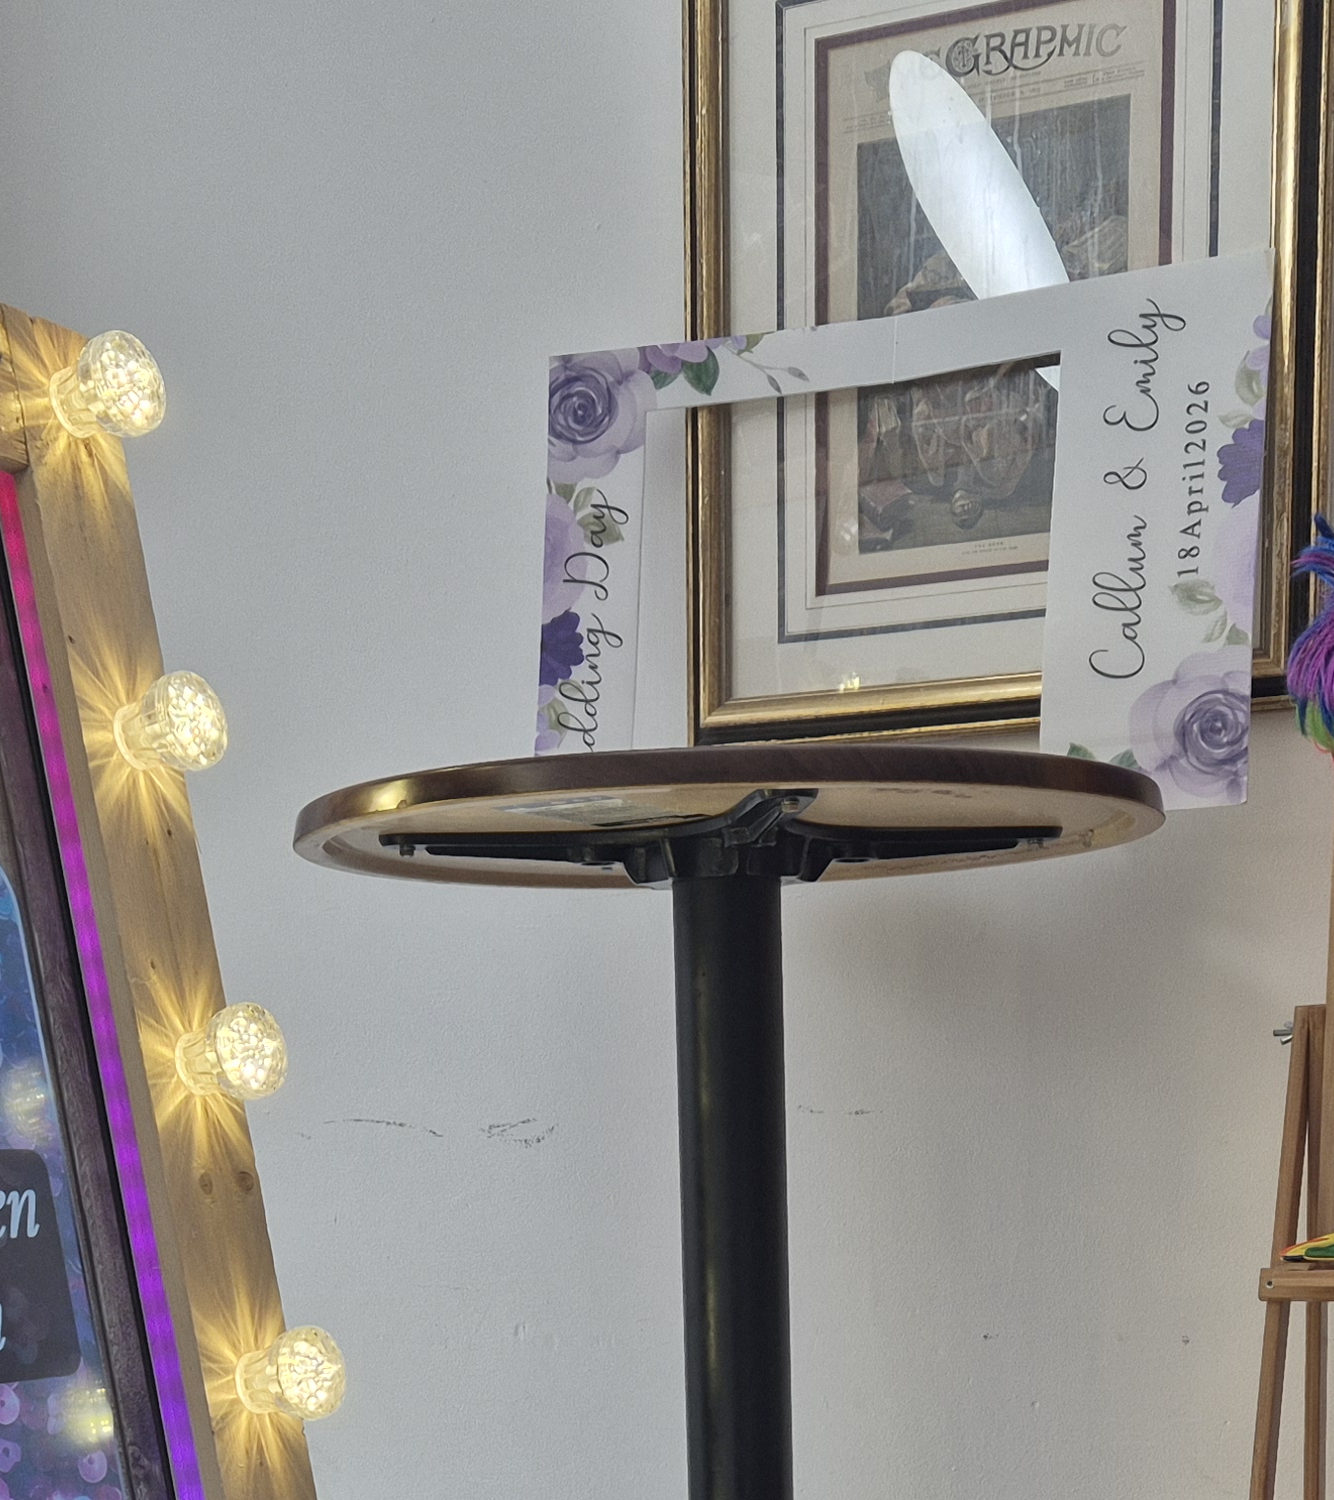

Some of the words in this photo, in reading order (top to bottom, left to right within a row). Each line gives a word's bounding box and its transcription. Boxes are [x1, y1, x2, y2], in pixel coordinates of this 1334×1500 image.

[945, 23, 1128, 77] GRAPHIC
[1102, 297, 1187, 432] Emily
[1103, 456, 1148, 491] &
[562, 488, 629, 602] Day
[1088, 514, 1148, 680] Callum
[556, 612, 624, 753] dding
